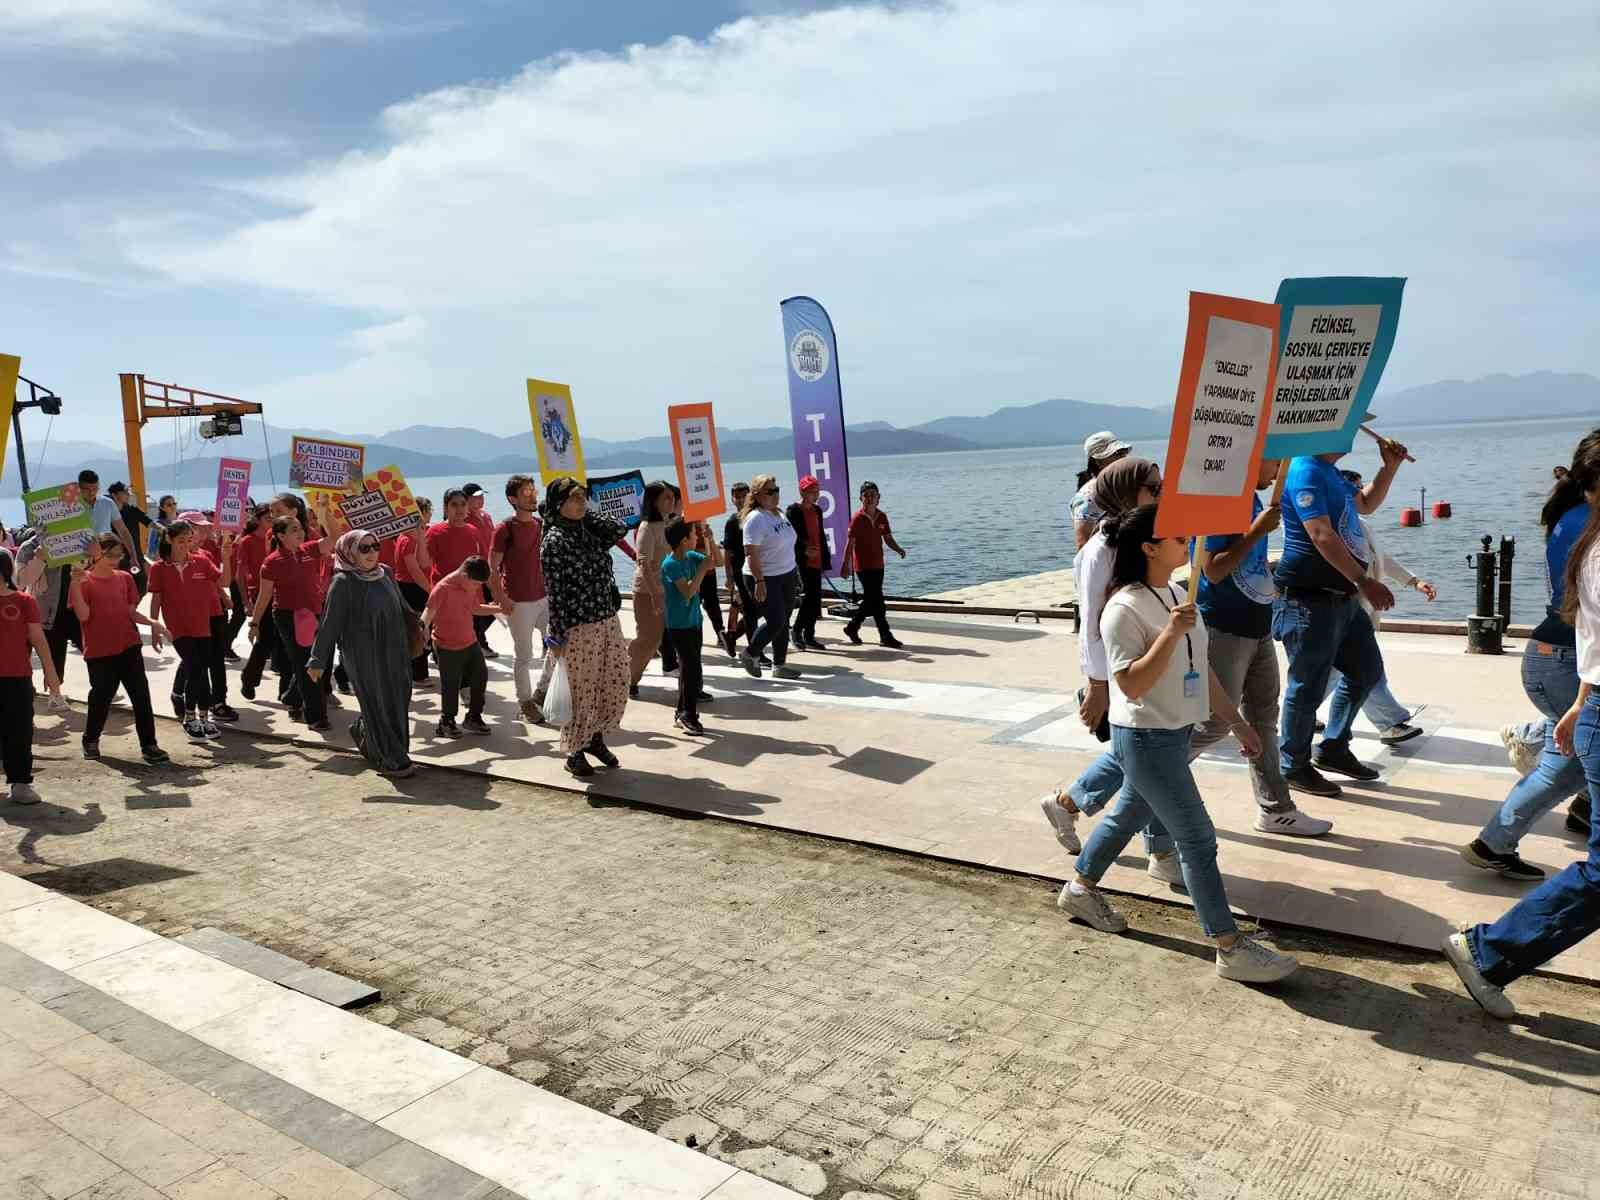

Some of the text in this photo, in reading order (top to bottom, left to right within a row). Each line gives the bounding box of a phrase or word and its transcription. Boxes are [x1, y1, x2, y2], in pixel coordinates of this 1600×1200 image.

[1310, 314, 1357, 336] FİZİKSEL,
[1285, 342, 1372, 361] SOSYAL ÇERVEYE
[1286, 361, 1357, 384] ULAŞMAK İÇİN
[1204, 384, 1240, 400] YAPAMAM
[1276, 408, 1339, 424] HAKKIMIZDIR
[352, 510, 389, 526] ENGEL
